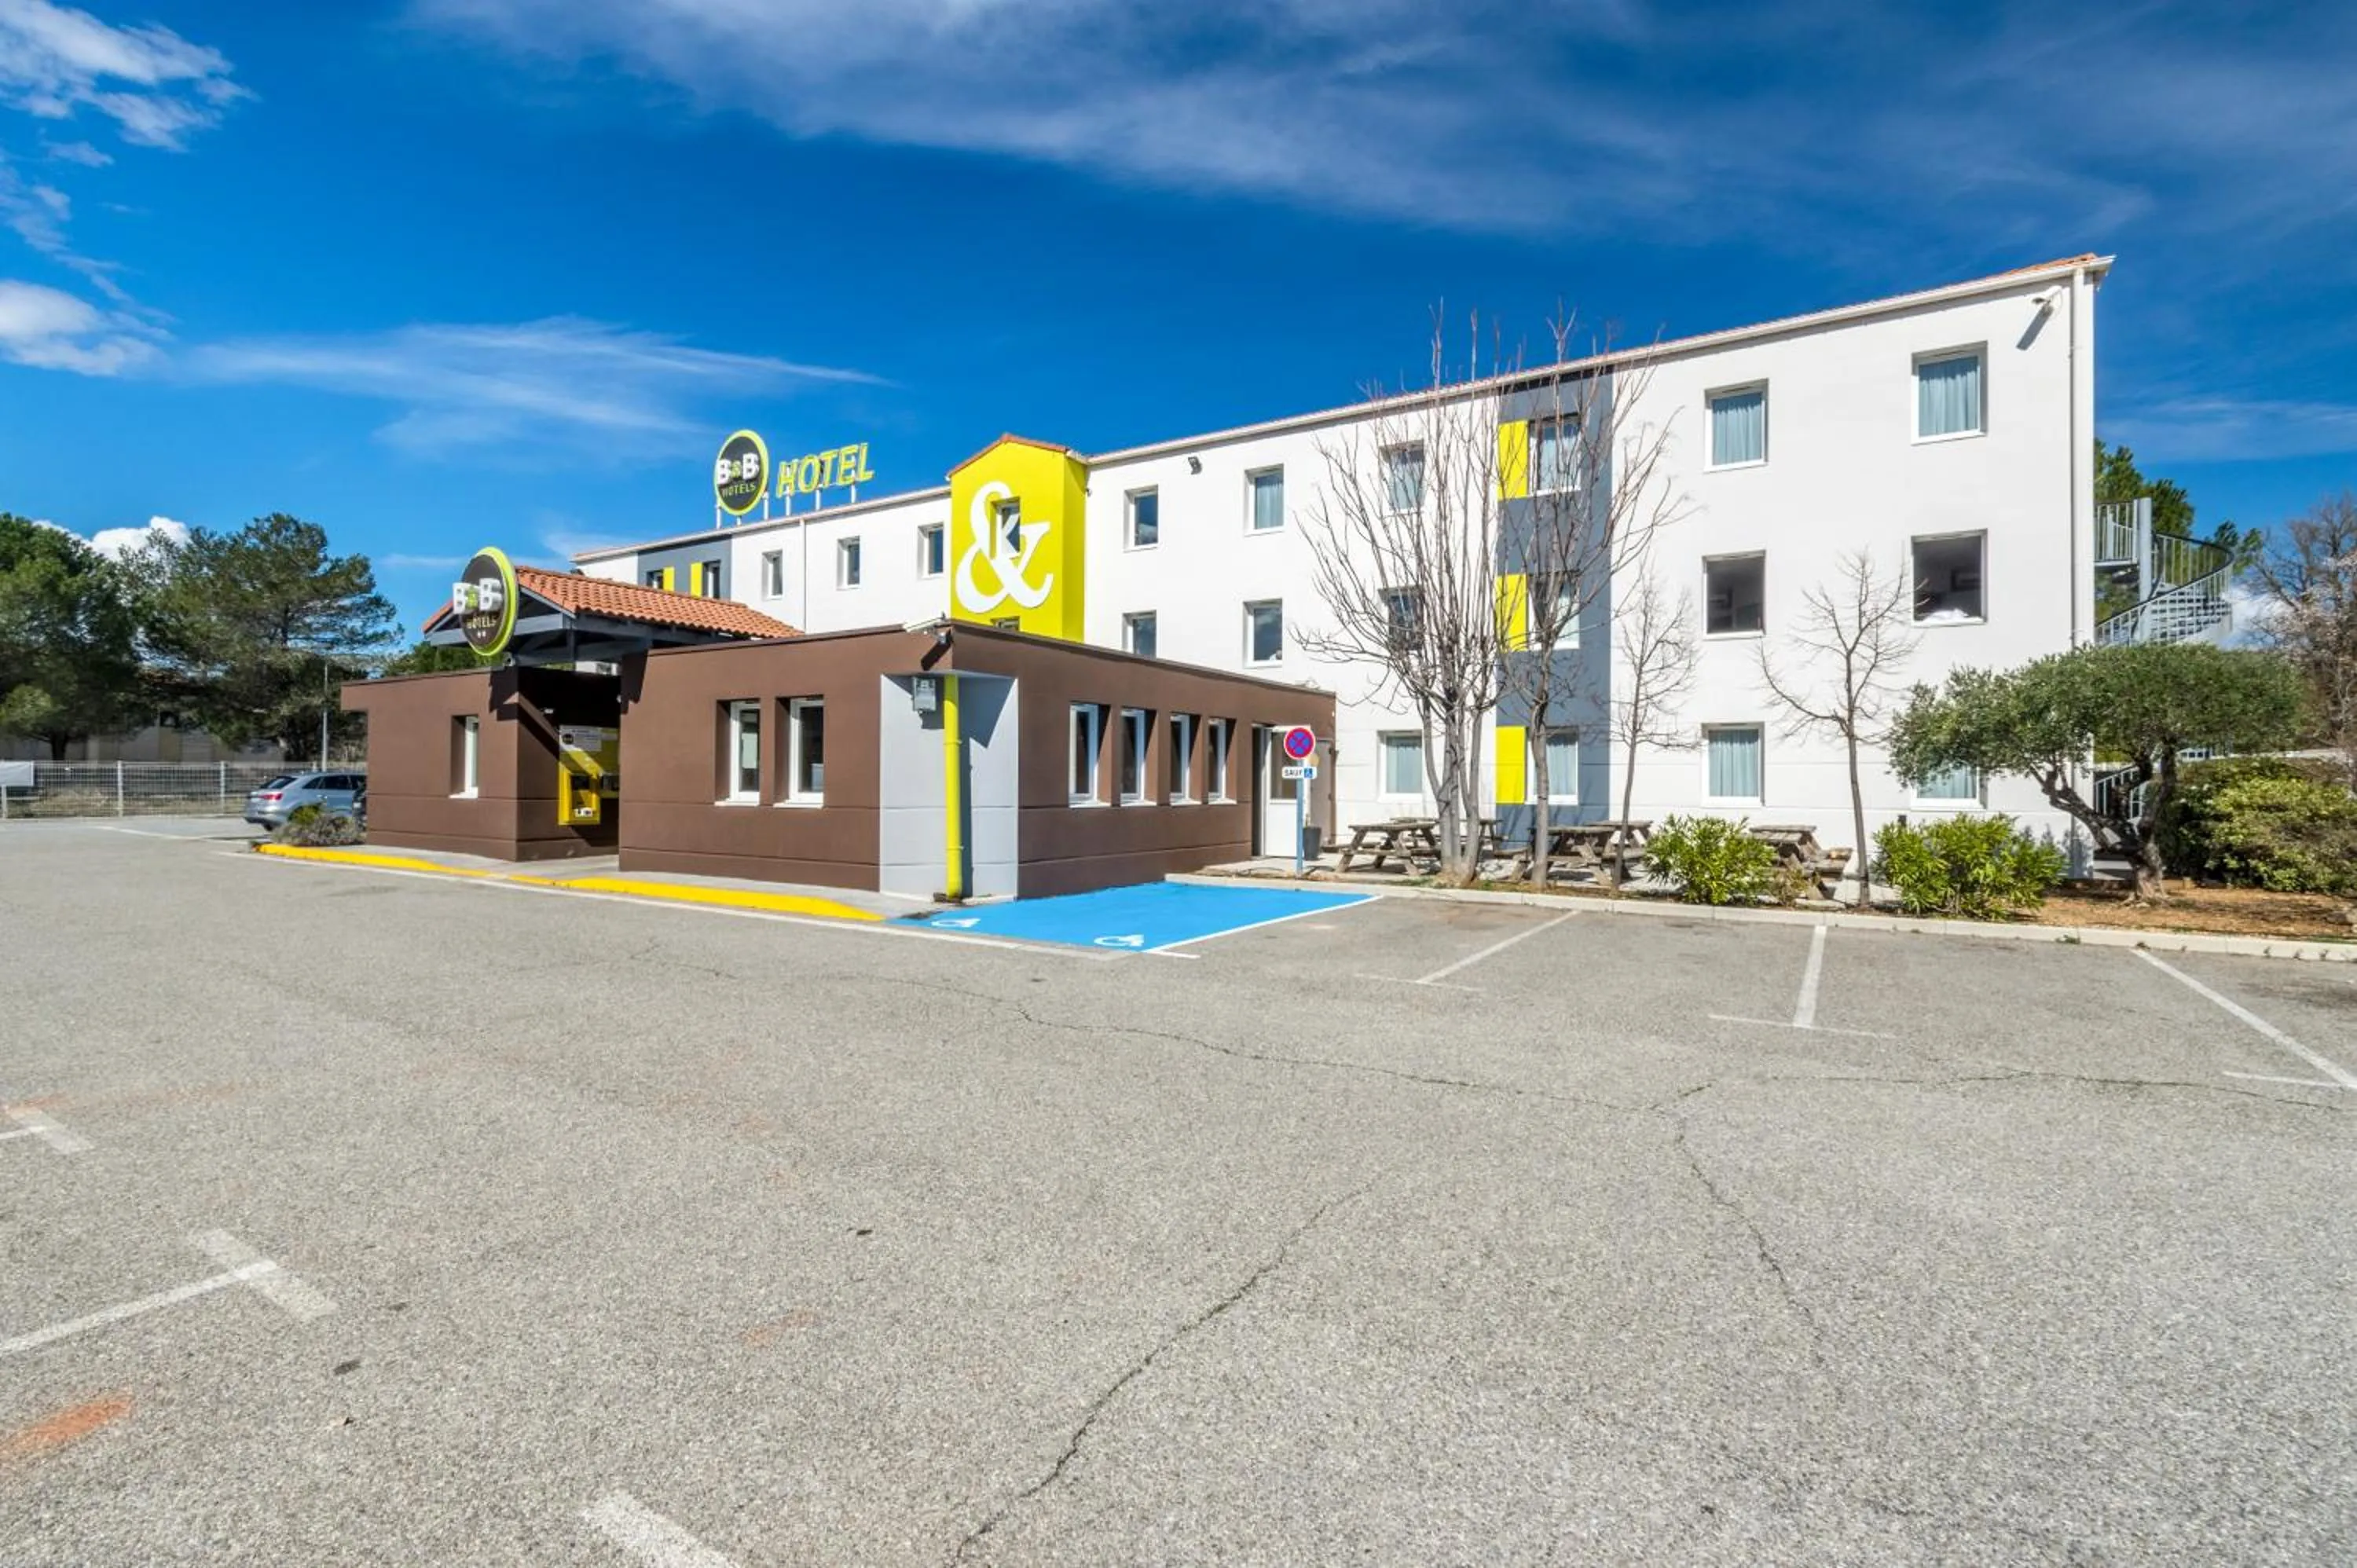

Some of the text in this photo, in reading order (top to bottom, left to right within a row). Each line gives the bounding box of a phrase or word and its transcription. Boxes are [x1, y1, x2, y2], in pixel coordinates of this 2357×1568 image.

[776, 442, 875, 498] HOTEL
[721, 482, 756, 497] HOTELS
[1284, 768, 1302, 777] SAUF
